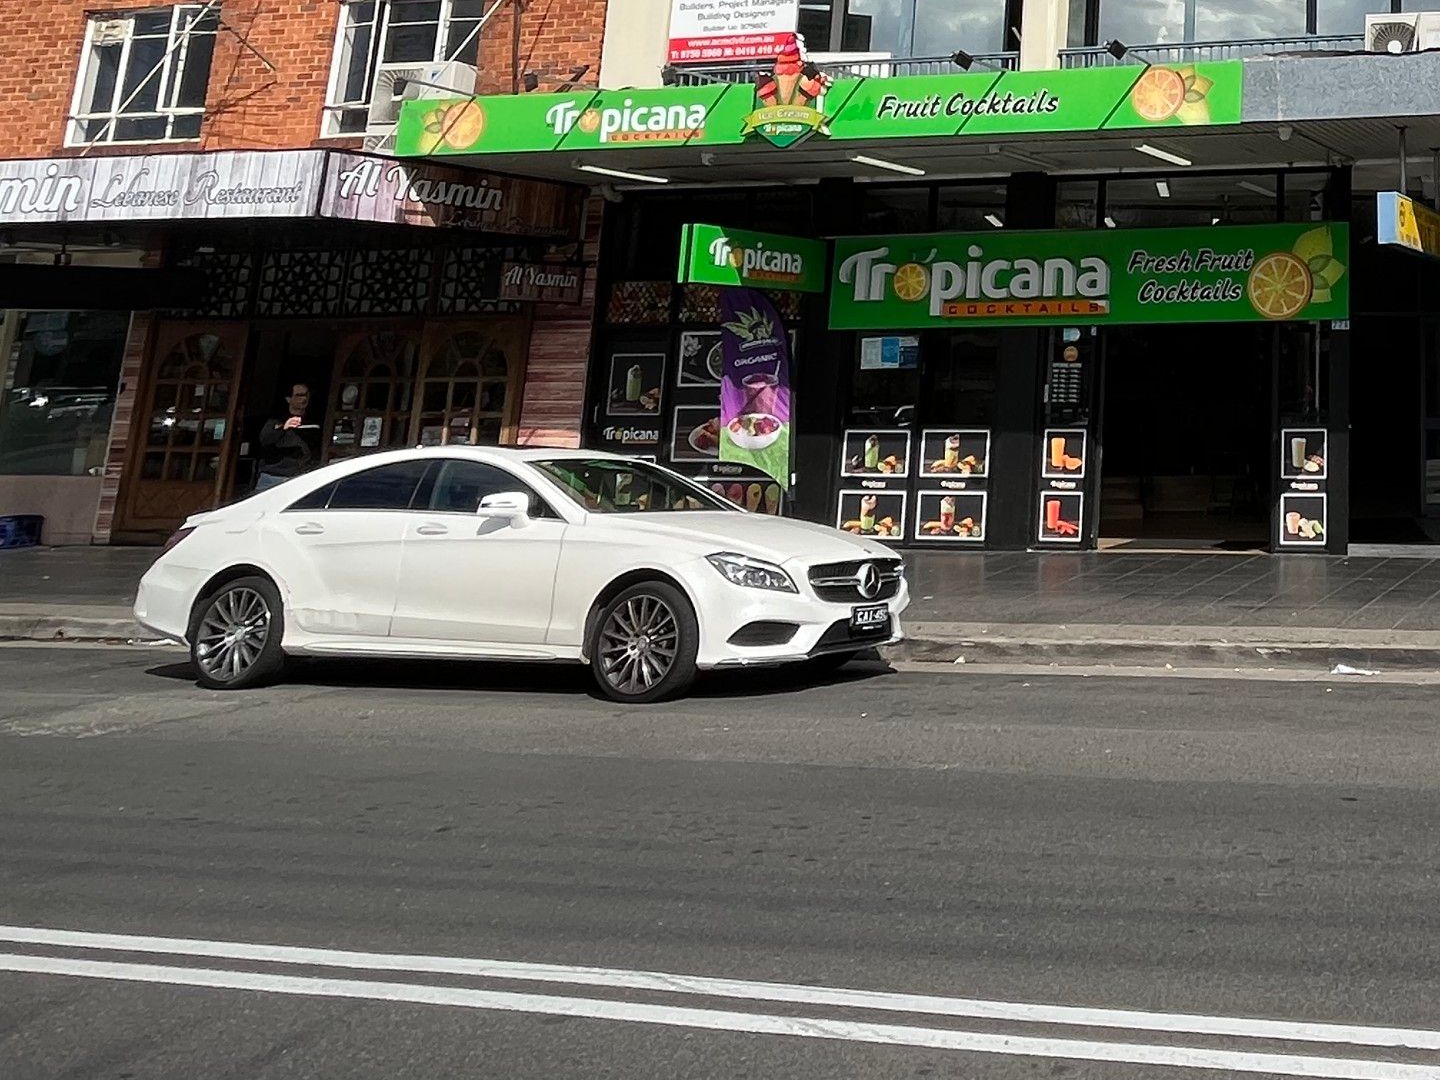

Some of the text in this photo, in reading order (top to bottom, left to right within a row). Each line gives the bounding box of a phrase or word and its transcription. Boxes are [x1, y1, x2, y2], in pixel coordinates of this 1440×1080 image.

[697, 9, 775, 21] Building Designers
[719, 0, 749, 9] Project
[777, 109, 811, 120] Cream
[876, 88, 1059, 119] Fruit Cocktails
[546, 99, 706, 143] Tropicana
[185, 170, 303, 206] Restaurant
[340, 159, 503, 211] Al Yasmin
[708, 237, 803, 277] Tropicana
[1127, 247, 1255, 273] Fresh Fruit
[505, 266, 577, 288] Al Yasmin
[839, 244, 1111, 316] Tropicana
[1138, 279, 1243, 304] Cocktails
[948, 302, 1100, 314] COCKTAILS
[734, 352, 778, 367] ORGANIC
[603, 426, 659, 442] Tropicana
